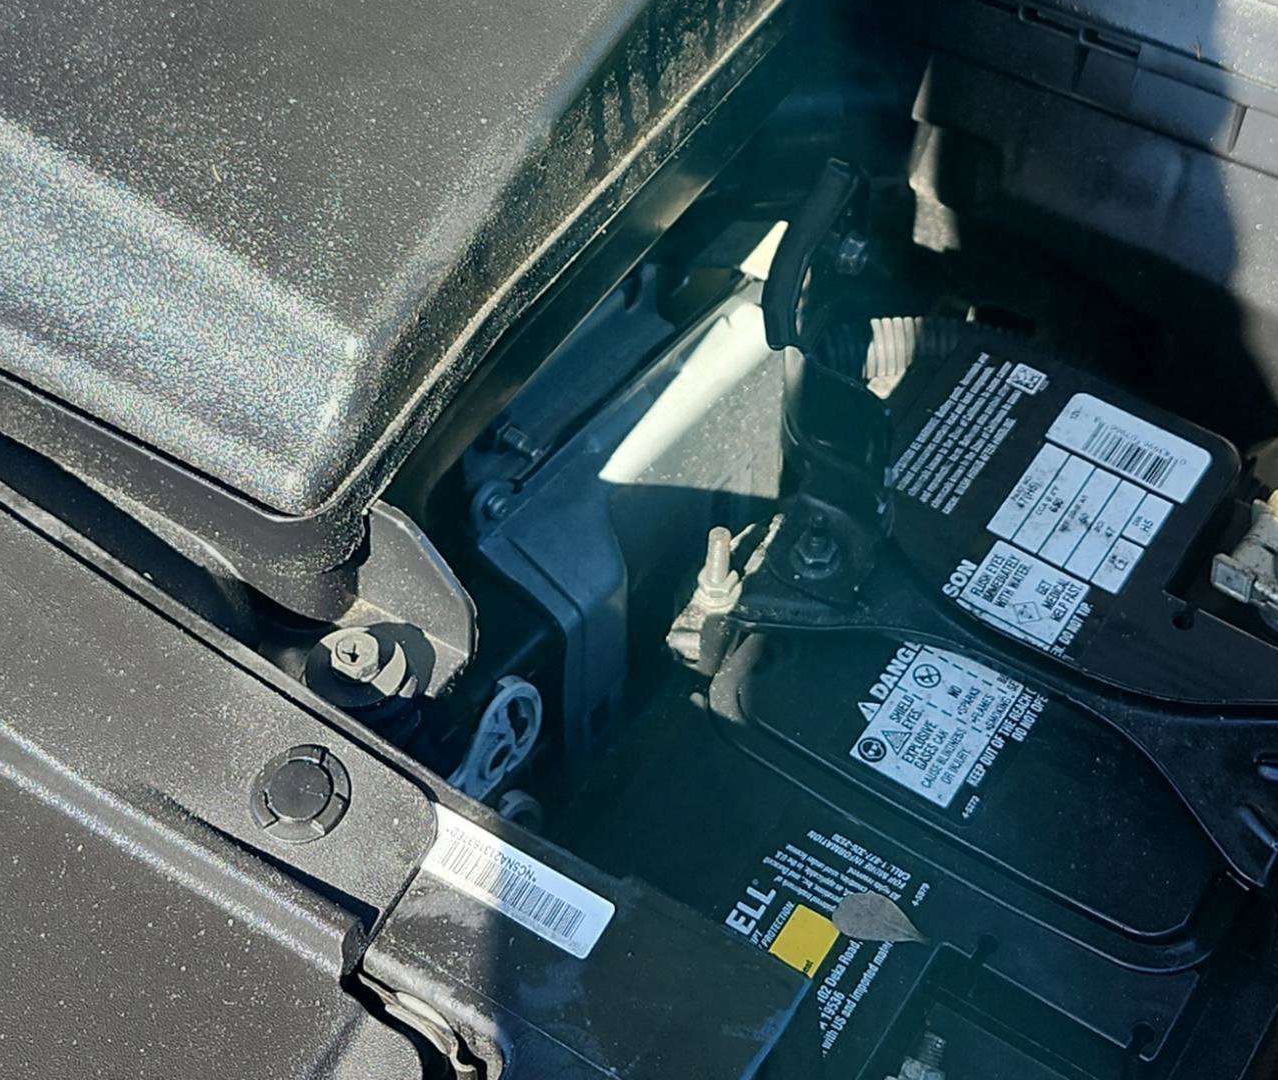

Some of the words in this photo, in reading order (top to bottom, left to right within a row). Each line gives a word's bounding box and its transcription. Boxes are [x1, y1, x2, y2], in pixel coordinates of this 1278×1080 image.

[1138, 518, 1154, 533] H5
[940, 557, 977, 599] SON
[969, 571, 992, 597] FLUSH
[984, 552, 1006, 574] EYES
[981, 552, 1021, 603] IMMEDIATELY
[1034, 578, 1052, 596] GET
[993, 586, 1015, 609] WITH
[1041, 576, 1070, 610] MEDICAL
[1049, 600, 1070, 623] HELP
[888, 693, 915, 723] SHIELD
[946, 683, 963, 699] NO
[1011, 726, 1027, 741] DO
[1019, 709, 1038, 729] NOT
[1030, 693, 1048, 712] OPE
[900, 718, 938, 764] EXPLOSIVE
[913, 742, 939, 771] GASES
[931, 727, 949, 745] CAN
[965, 762, 987, 786] KEEP
[979, 745, 998, 765] OUT
[990, 733, 1006, 748] OF
[998, 717, 1016, 736] THE
[1008, 692, 1033, 721] REACH
[919, 762, 942, 789] CAUSE
[935, 726, 967, 765] BLINDNESS
[804, 828, 865, 866] INFORMATION
[862, 861, 889, 880] MORE
[886, 874, 906, 889] FOR
[724, 885, 778, 937] ELL
[823, 961, 847, 988] Deka
[819, 988, 846, 1022] 19536
[838, 998, 857, 1018] and
[830, 1014, 847, 1031] US
